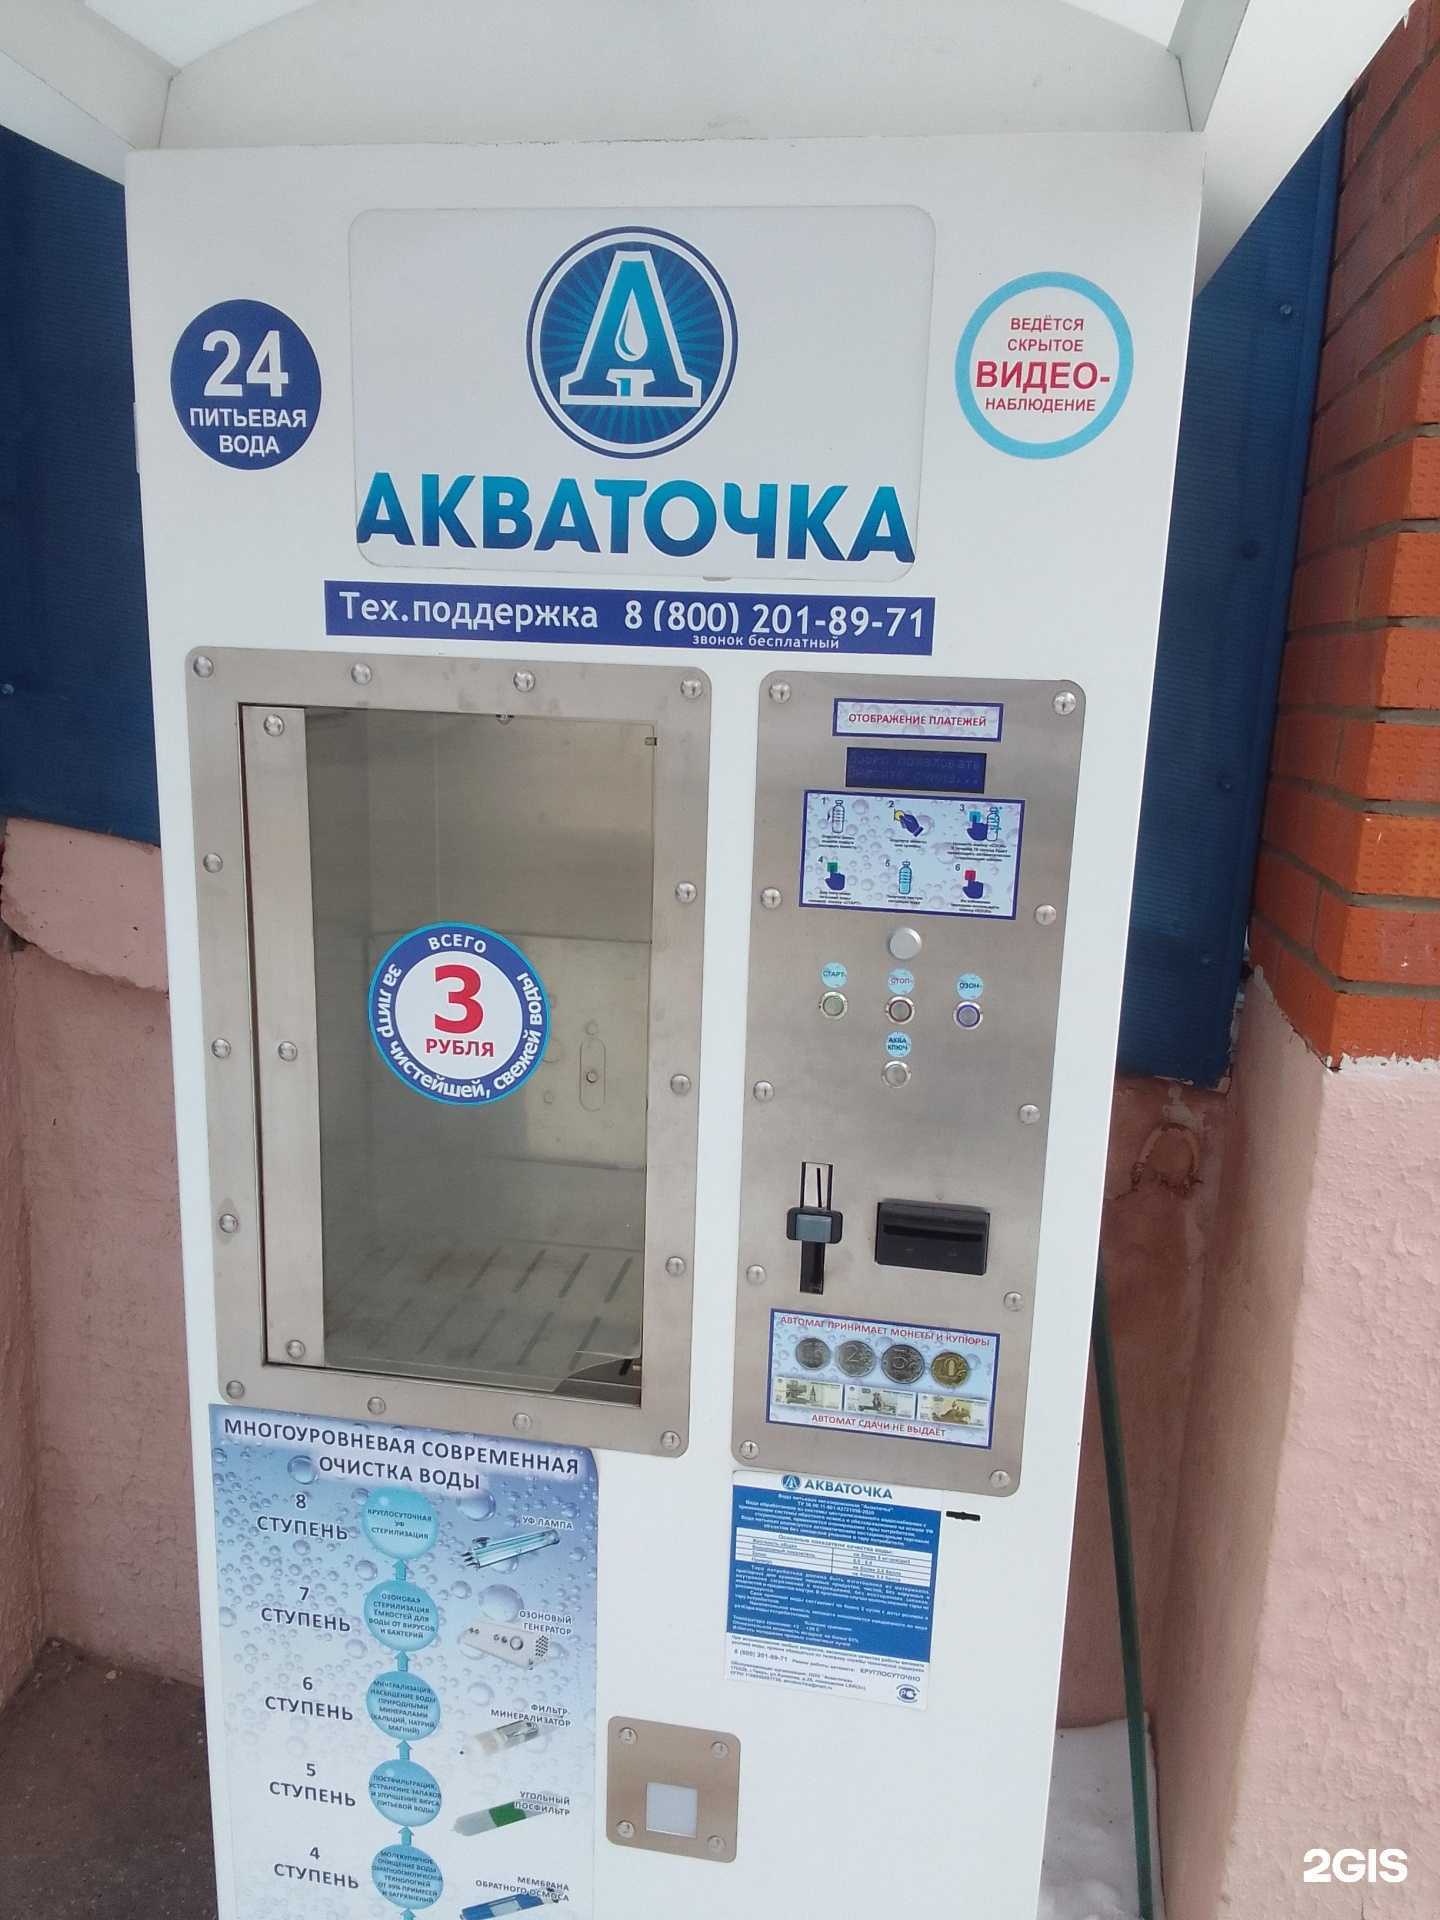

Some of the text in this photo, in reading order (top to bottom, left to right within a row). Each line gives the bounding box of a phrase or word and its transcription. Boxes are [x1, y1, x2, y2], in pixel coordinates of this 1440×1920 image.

[1011, 315, 1084, 332] ВЕДЁТСЯ
[1007, 338, 1083, 352] СКРЫТОЕ
[203, 329, 289, 397] 24
[976, 361, 1110, 393] ВИДЕО-
[985, 398, 1095, 412] НАБЛЮДЕНИЕ
[189, 408, 307, 429] ПИТЬЕВАЯ
[218, 435, 280, 457] ВОДА
[356, 471, 916, 564] АКВАТОЧКА
[624, 602, 642, 628] 8
[653, 602, 739, 634] (800)
[752, 605, 923, 637] 201-89-71
[692, 634, 839, 649] звонок бесплатный
[849, 713, 986, 726] ОТОБРАЖЕНИЕ ПЛАТЕЖЕЙ
[960, 804, 965, 812] 3
[428, 934, 486, 953] ВСЕГО
[383, 963, 402, 987] за
[434, 964, 484, 1034] 3
[517, 973, 542, 1025] воды
[376, 989, 394, 1038] литр
[426, 1039, 494, 1057] РУБЛЯ
[493, 1029, 542, 1090] свежей
[781, 1316, 990, 1346] АВТОМАТ ПРИНИМАЕТ МОНЕТЫ И КУПЮРЫ
[812, 1414, 855, 1426] АВТОМАТ
[858, 1419, 890, 1430] СДАЧИ
[892, 1424, 905, 1432] НЕ
[225, 1418, 579, 1474] МНОГОУРОВНЕВАЯ СОВРЕМЕННАЯ
[319, 1456, 480, 1489] ОЧИСТКА ВОДЫ
[805, 1479, 892, 1499] АКВАТОЧКА
[296, 1494, 306, 1509] 8
[257, 1516, 348, 1540] СТУПЕНЬ
[523, 1516, 572, 1529] УФ ЛАМПА
[299, 1587, 309, 1600] 7
[262, 1607, 351, 1632] СТУПЕНЬ
[520, 1610, 572, 1624] ОЗОНОВЫЙ
[524, 1623, 572, 1635] ГЕНЕРАТОР
[303, 1677, 313, 1690] 6
[265, 1696, 353, 1721] СТУПЕНЬ
[491, 1709, 571, 1727] МИНЕРАЛИЗАТОР
[307, 1763, 316, 1777] 5
[269, 1781, 356, 1806] СТУПЕНЬ
[520, 1791, 570, 1805] УГОЛЬНЫЙ
[310, 1847, 320, 1860] 4
[274, 1863, 359, 1888] СТУПЕНЬ
[517, 1877, 569, 1891] МЕМБРАНА
[476, 1880, 569, 1901] ОБРАТНОГО ОСМОСА
